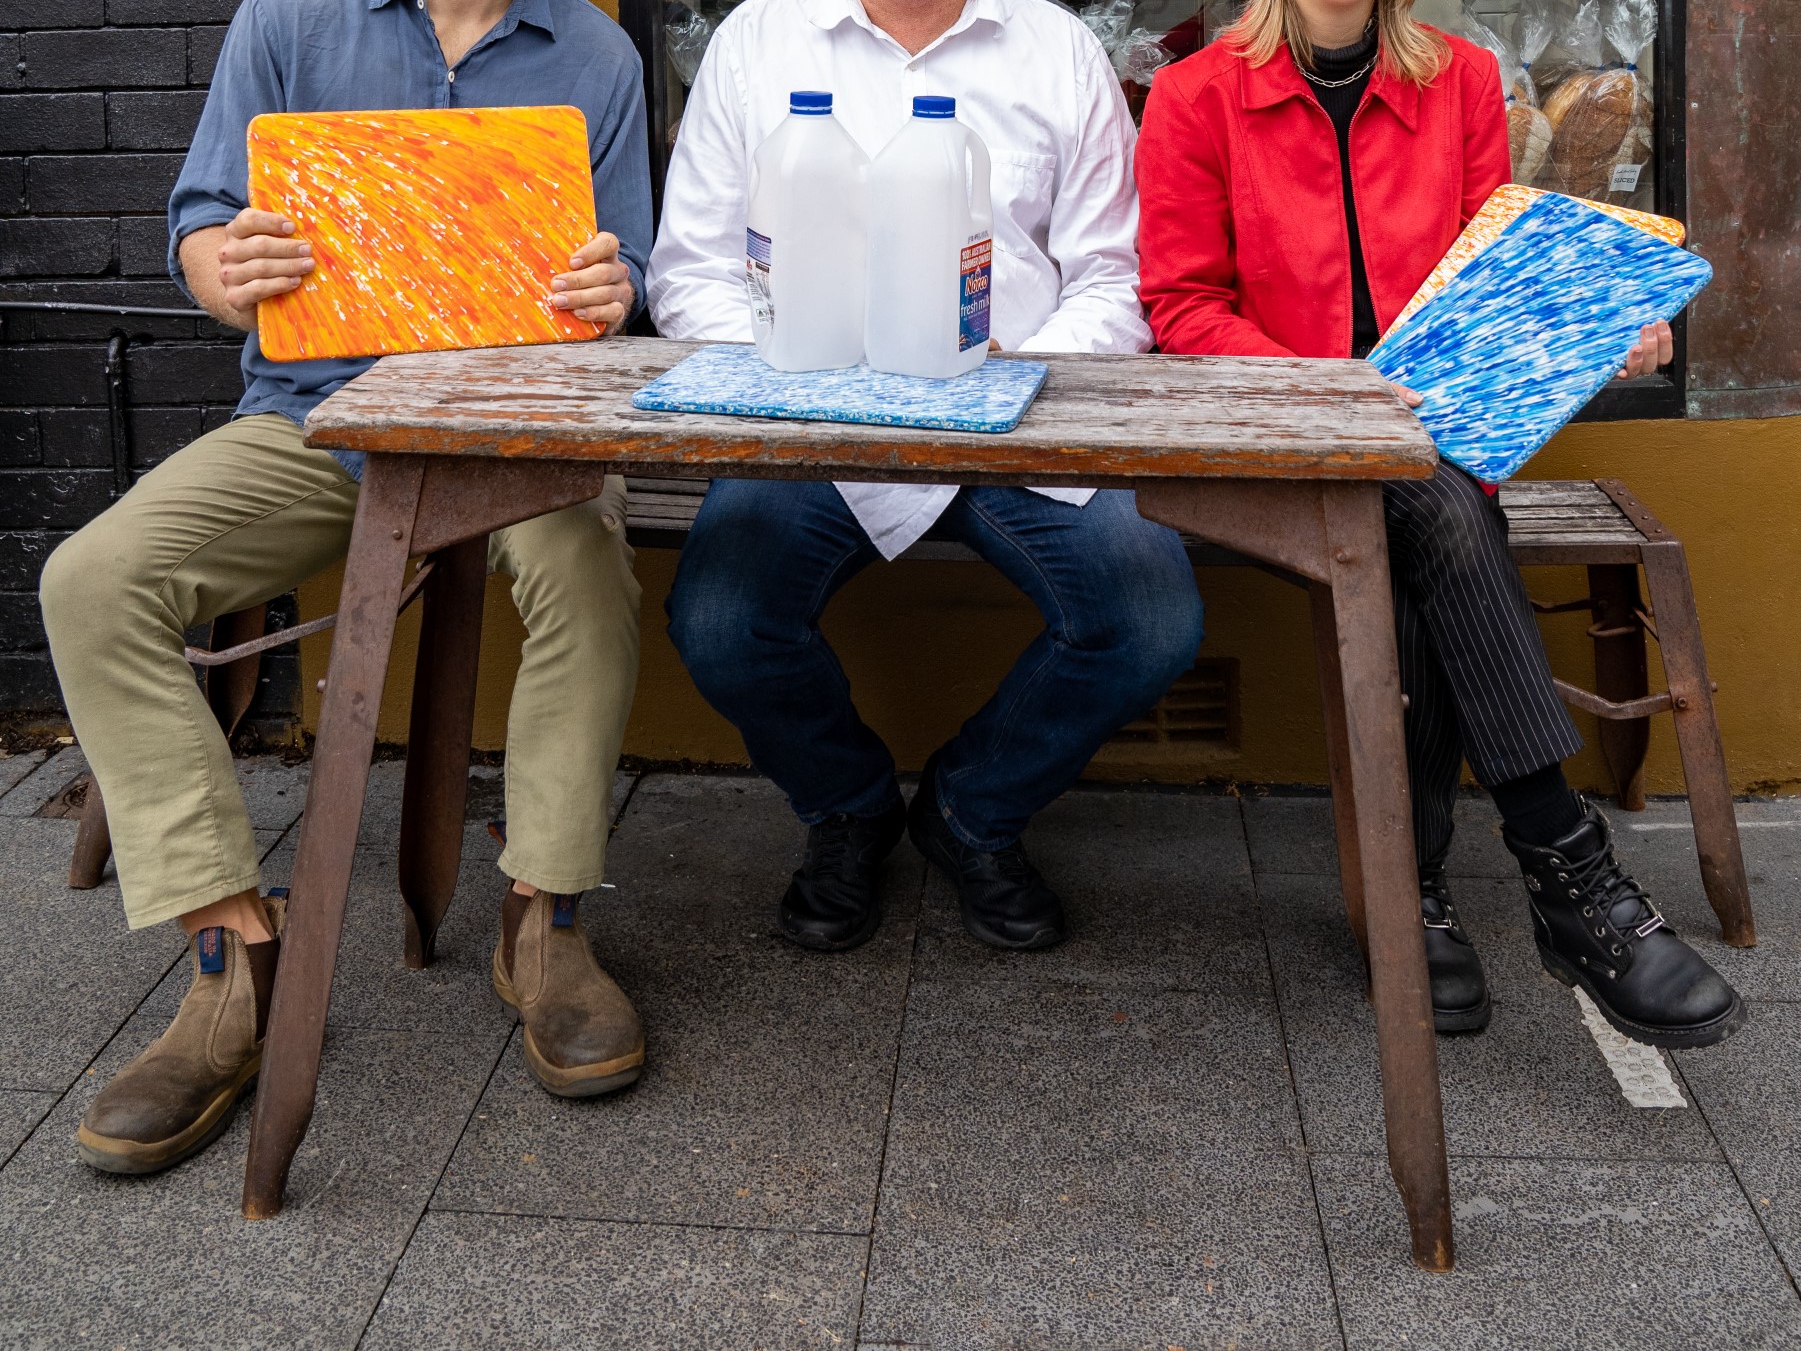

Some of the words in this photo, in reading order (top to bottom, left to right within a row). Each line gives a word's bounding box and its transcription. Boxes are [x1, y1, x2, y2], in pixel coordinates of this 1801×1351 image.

[965, 274, 988, 296] Norco
[960, 300, 978, 318] fresh
[978, 294, 990, 310] milk
